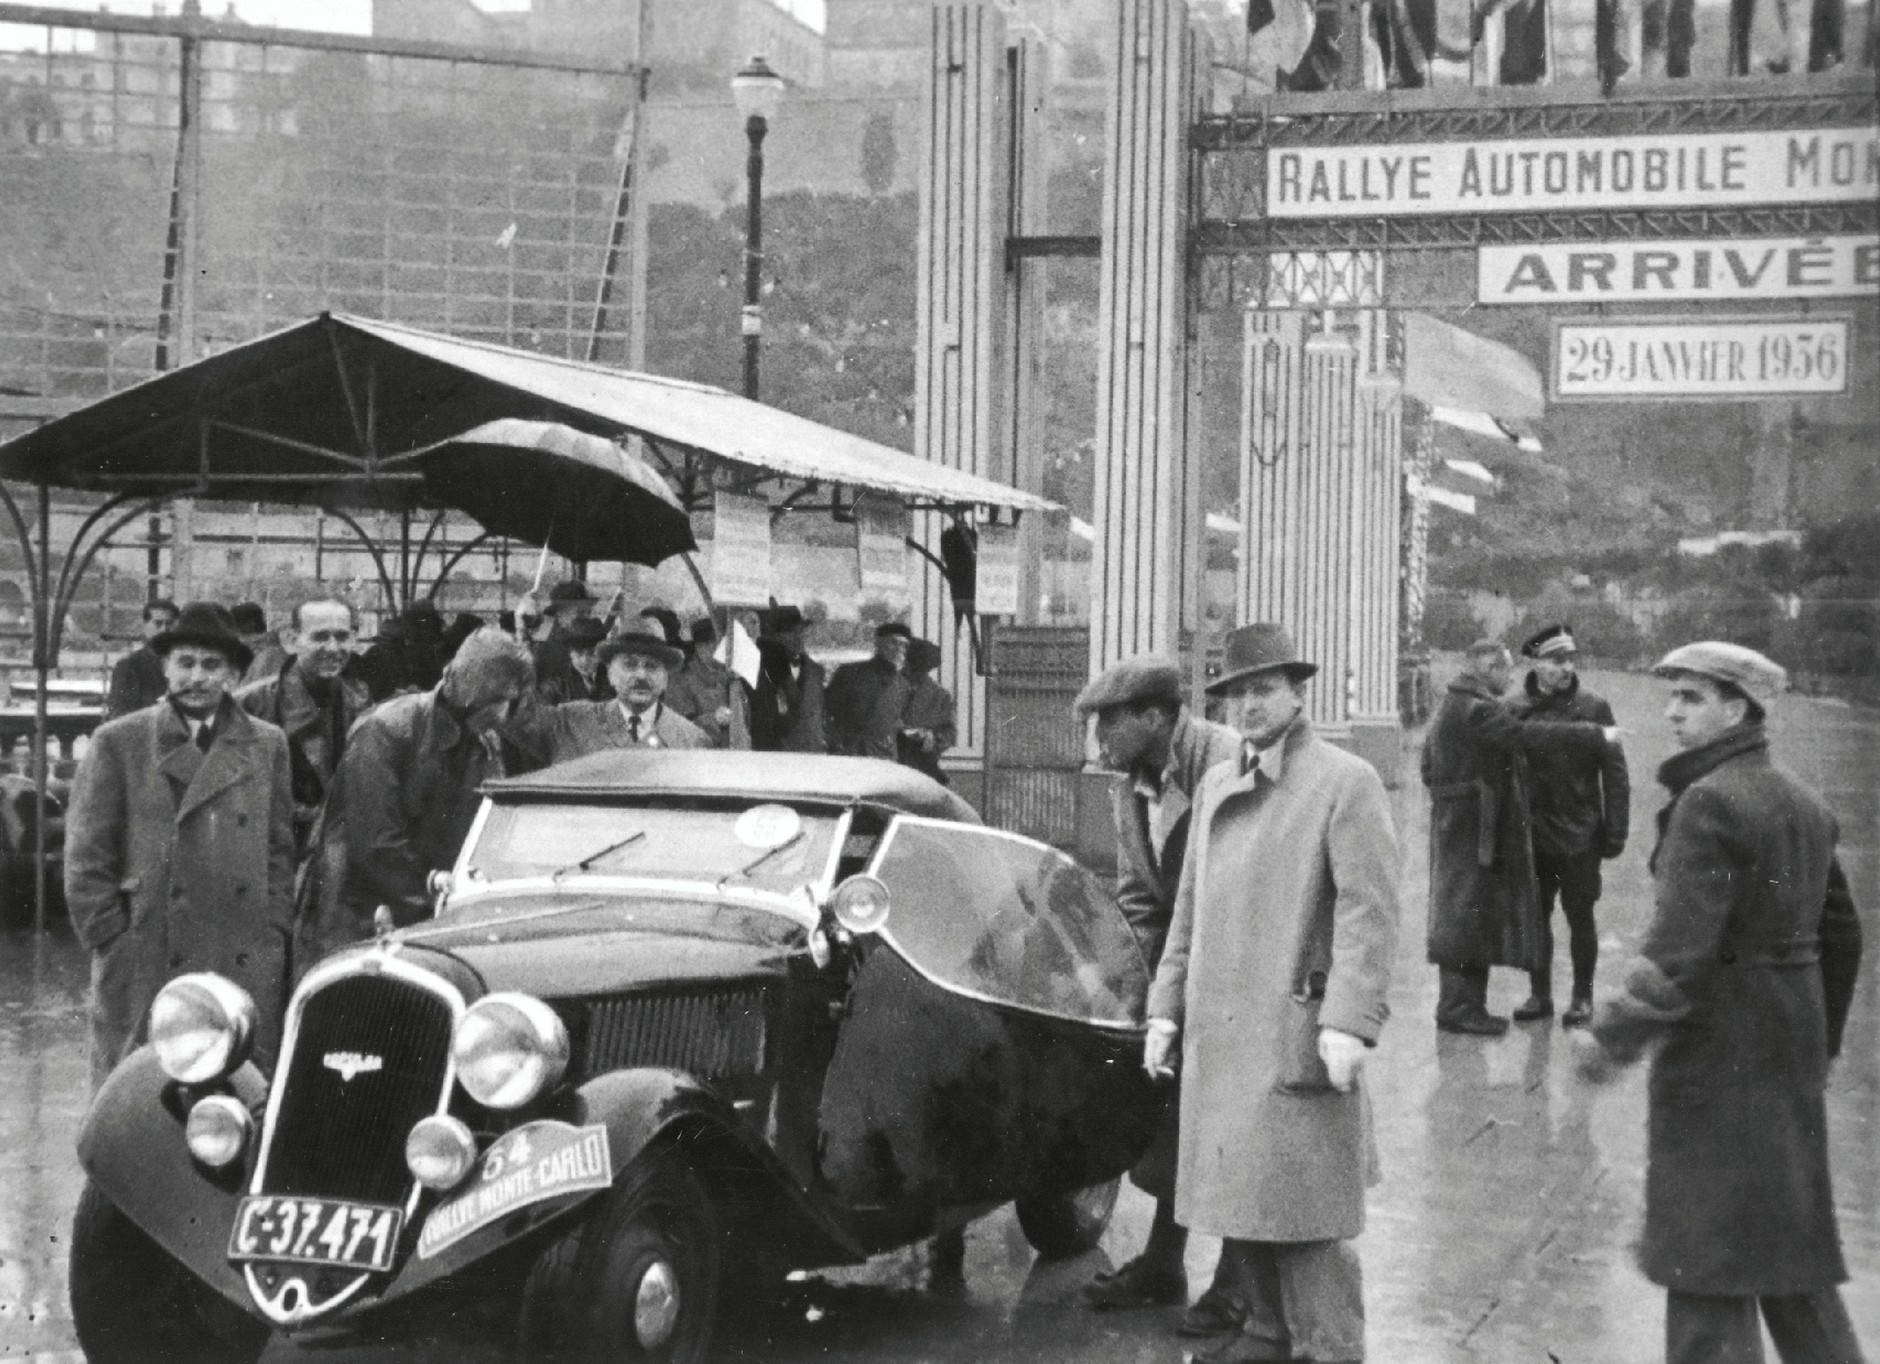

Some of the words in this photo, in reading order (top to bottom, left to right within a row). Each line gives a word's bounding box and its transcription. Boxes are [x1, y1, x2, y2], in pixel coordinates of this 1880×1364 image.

[1279, 153, 1432, 201] RALLYE
[1458, 145, 1747, 197] AUTOMOBILE
[1566, 335, 1614, 383] 29
[1619, 340, 1747, 382] JANVIER
